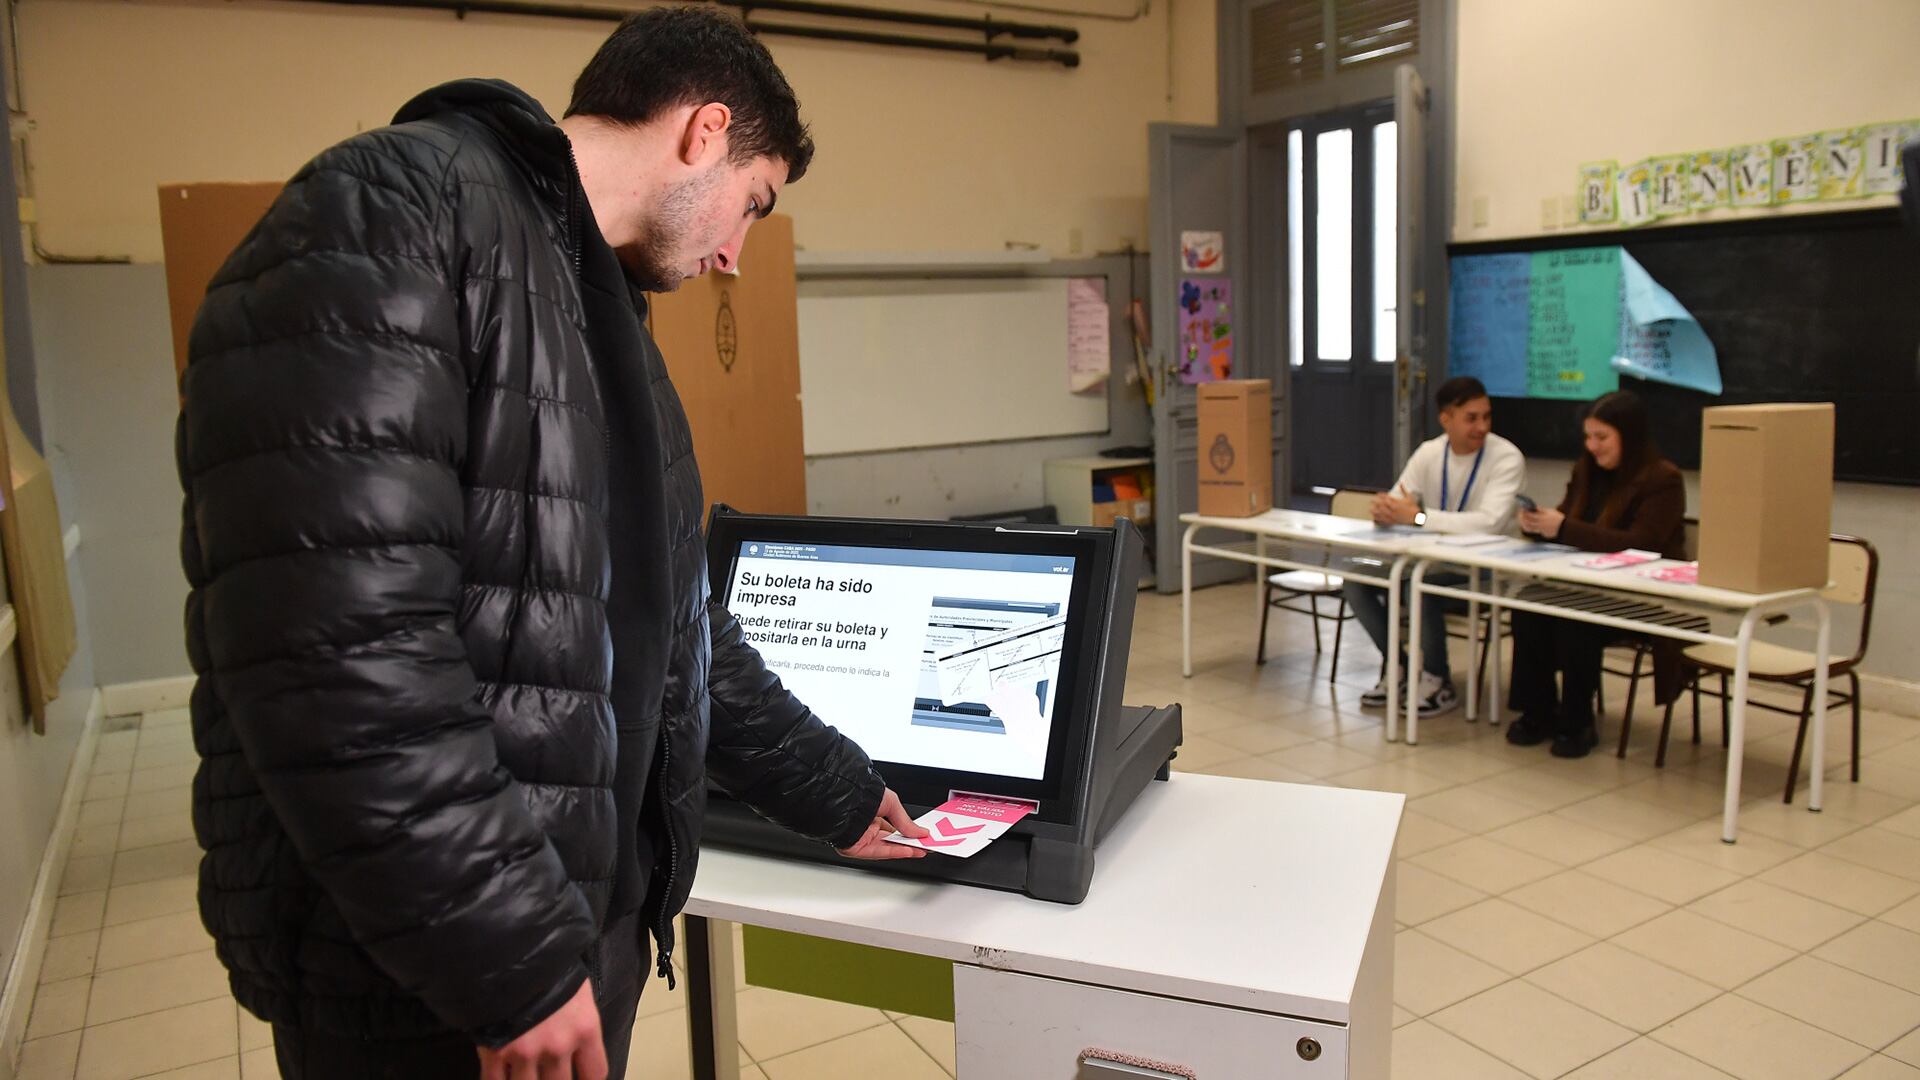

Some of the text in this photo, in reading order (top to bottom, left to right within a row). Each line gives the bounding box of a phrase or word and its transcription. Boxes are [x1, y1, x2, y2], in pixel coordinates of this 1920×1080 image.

[741, 572, 873, 593] Su boleta ha sido
[737, 589, 797, 607] impresa
[774, 618, 813, 631] retirar
[816, 622, 832, 632] su
[835, 621, 876, 636] boleta
[880, 627, 888, 640] y
[744, 631, 867, 651] positarla en la urna
[794, 661, 824, 672] proceda
[826, 665, 848, 674] como
[849, 666, 856, 675] lo
[857, 667, 881, 677] indica
[882, 669, 890, 677] la
